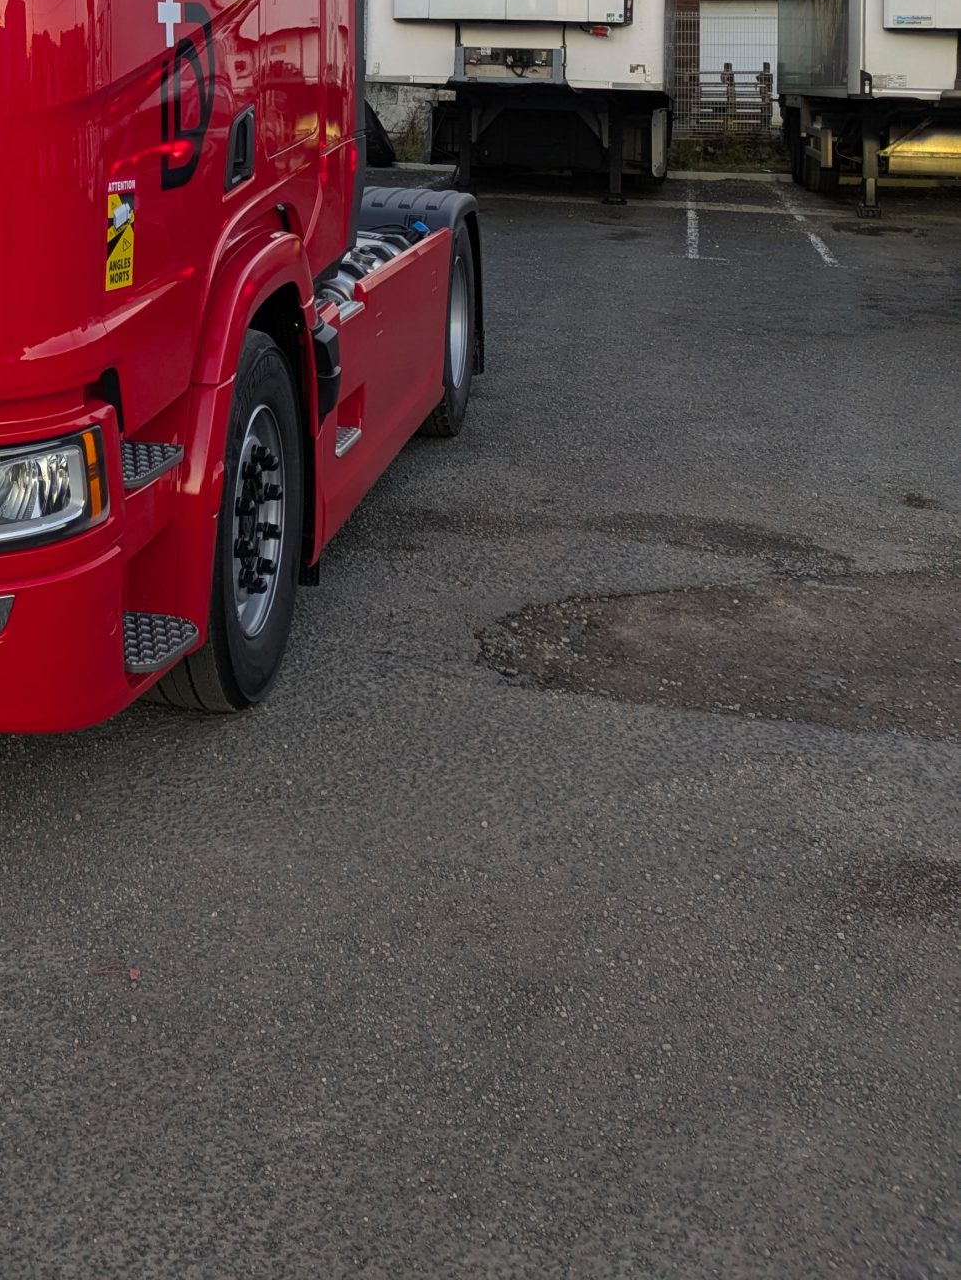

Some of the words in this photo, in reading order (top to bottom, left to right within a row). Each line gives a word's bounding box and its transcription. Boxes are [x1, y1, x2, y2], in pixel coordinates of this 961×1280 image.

[108, 180, 136, 193] ATTENTION
[109, 257, 131, 272] ANGLES
[109, 270, 130, 285] MORTS
